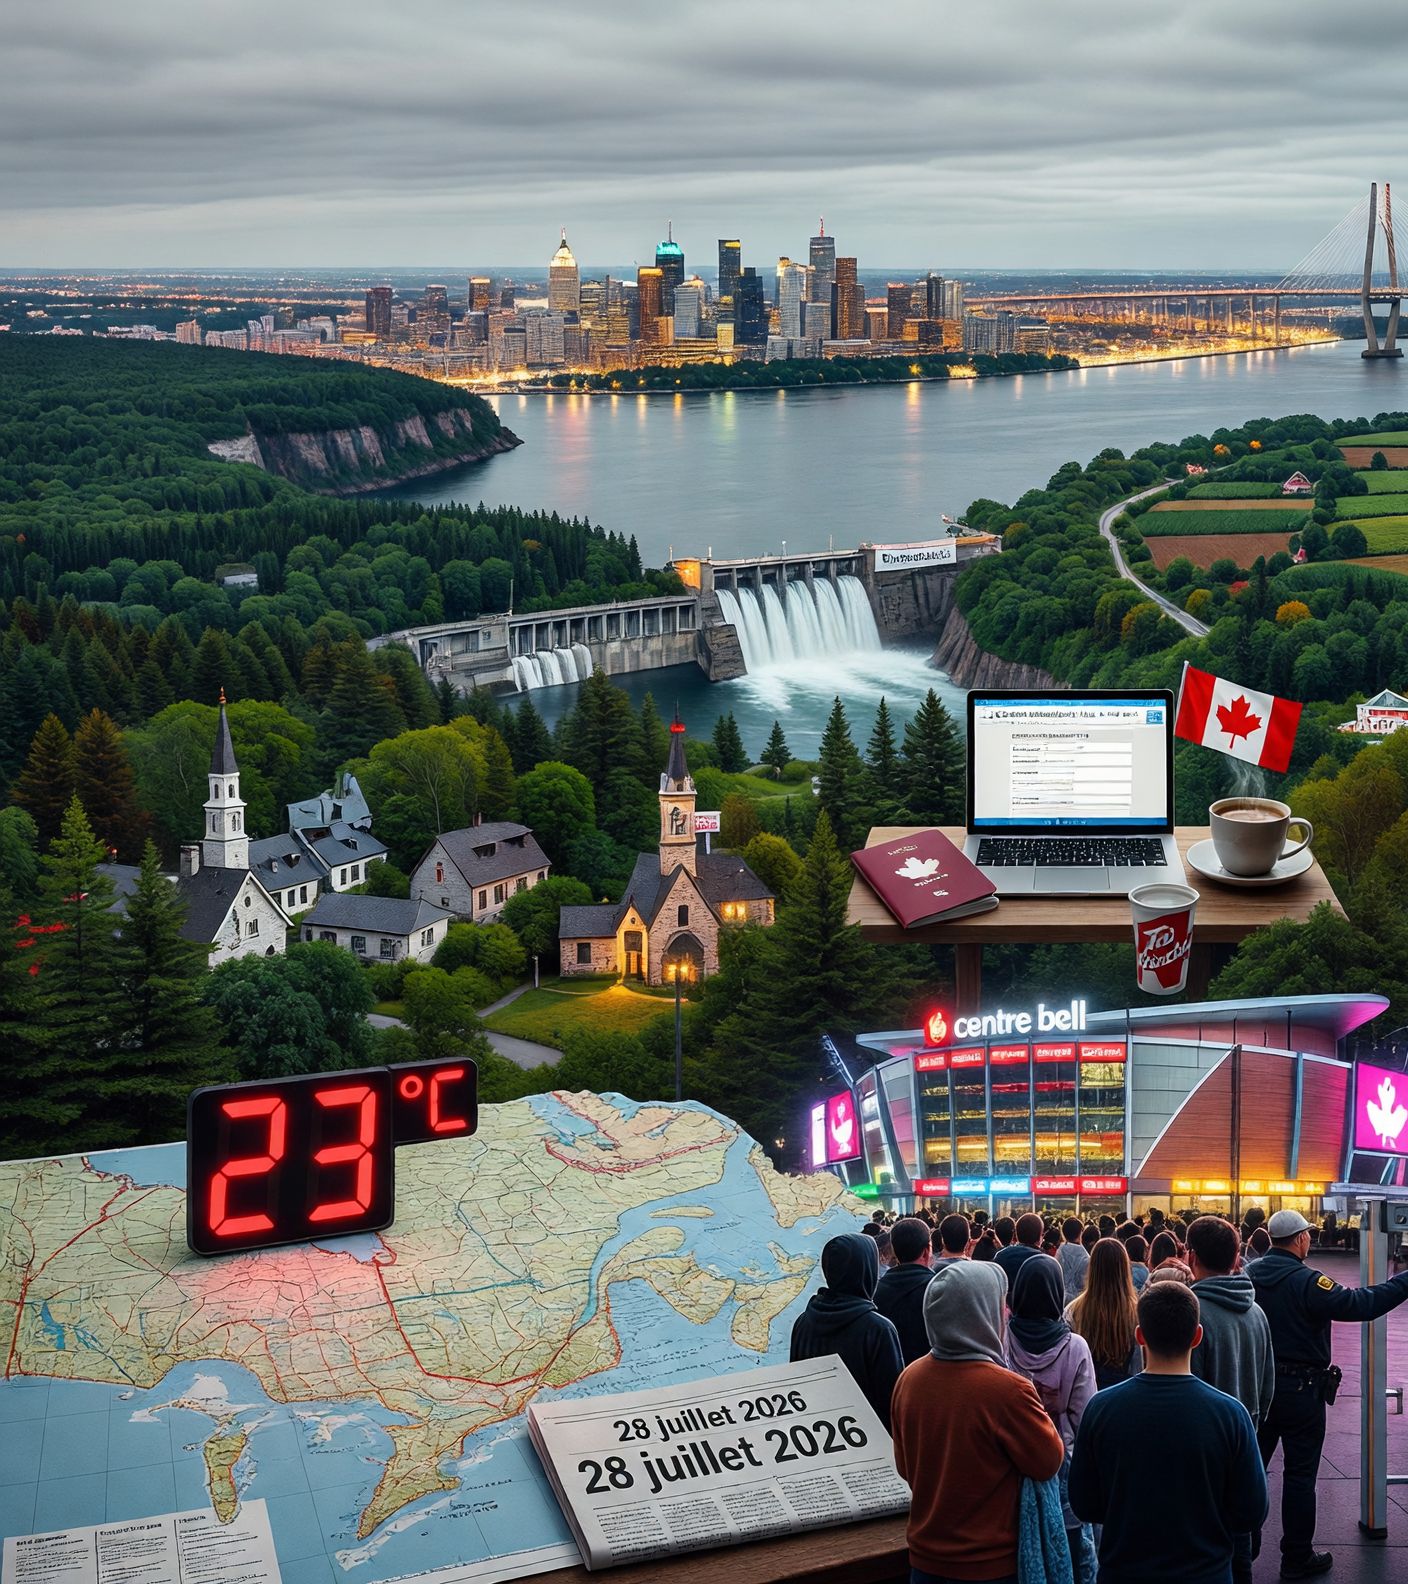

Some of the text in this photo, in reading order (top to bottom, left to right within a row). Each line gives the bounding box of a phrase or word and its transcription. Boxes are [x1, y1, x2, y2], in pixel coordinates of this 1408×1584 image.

[954, 999, 1087, 1039] centre bell
[209, 1069, 467, 1236] 23 °C
[613, 1390, 808, 1443] 28 juillet 2026
[578, 1415, 869, 1495] 28 juillet 2026
